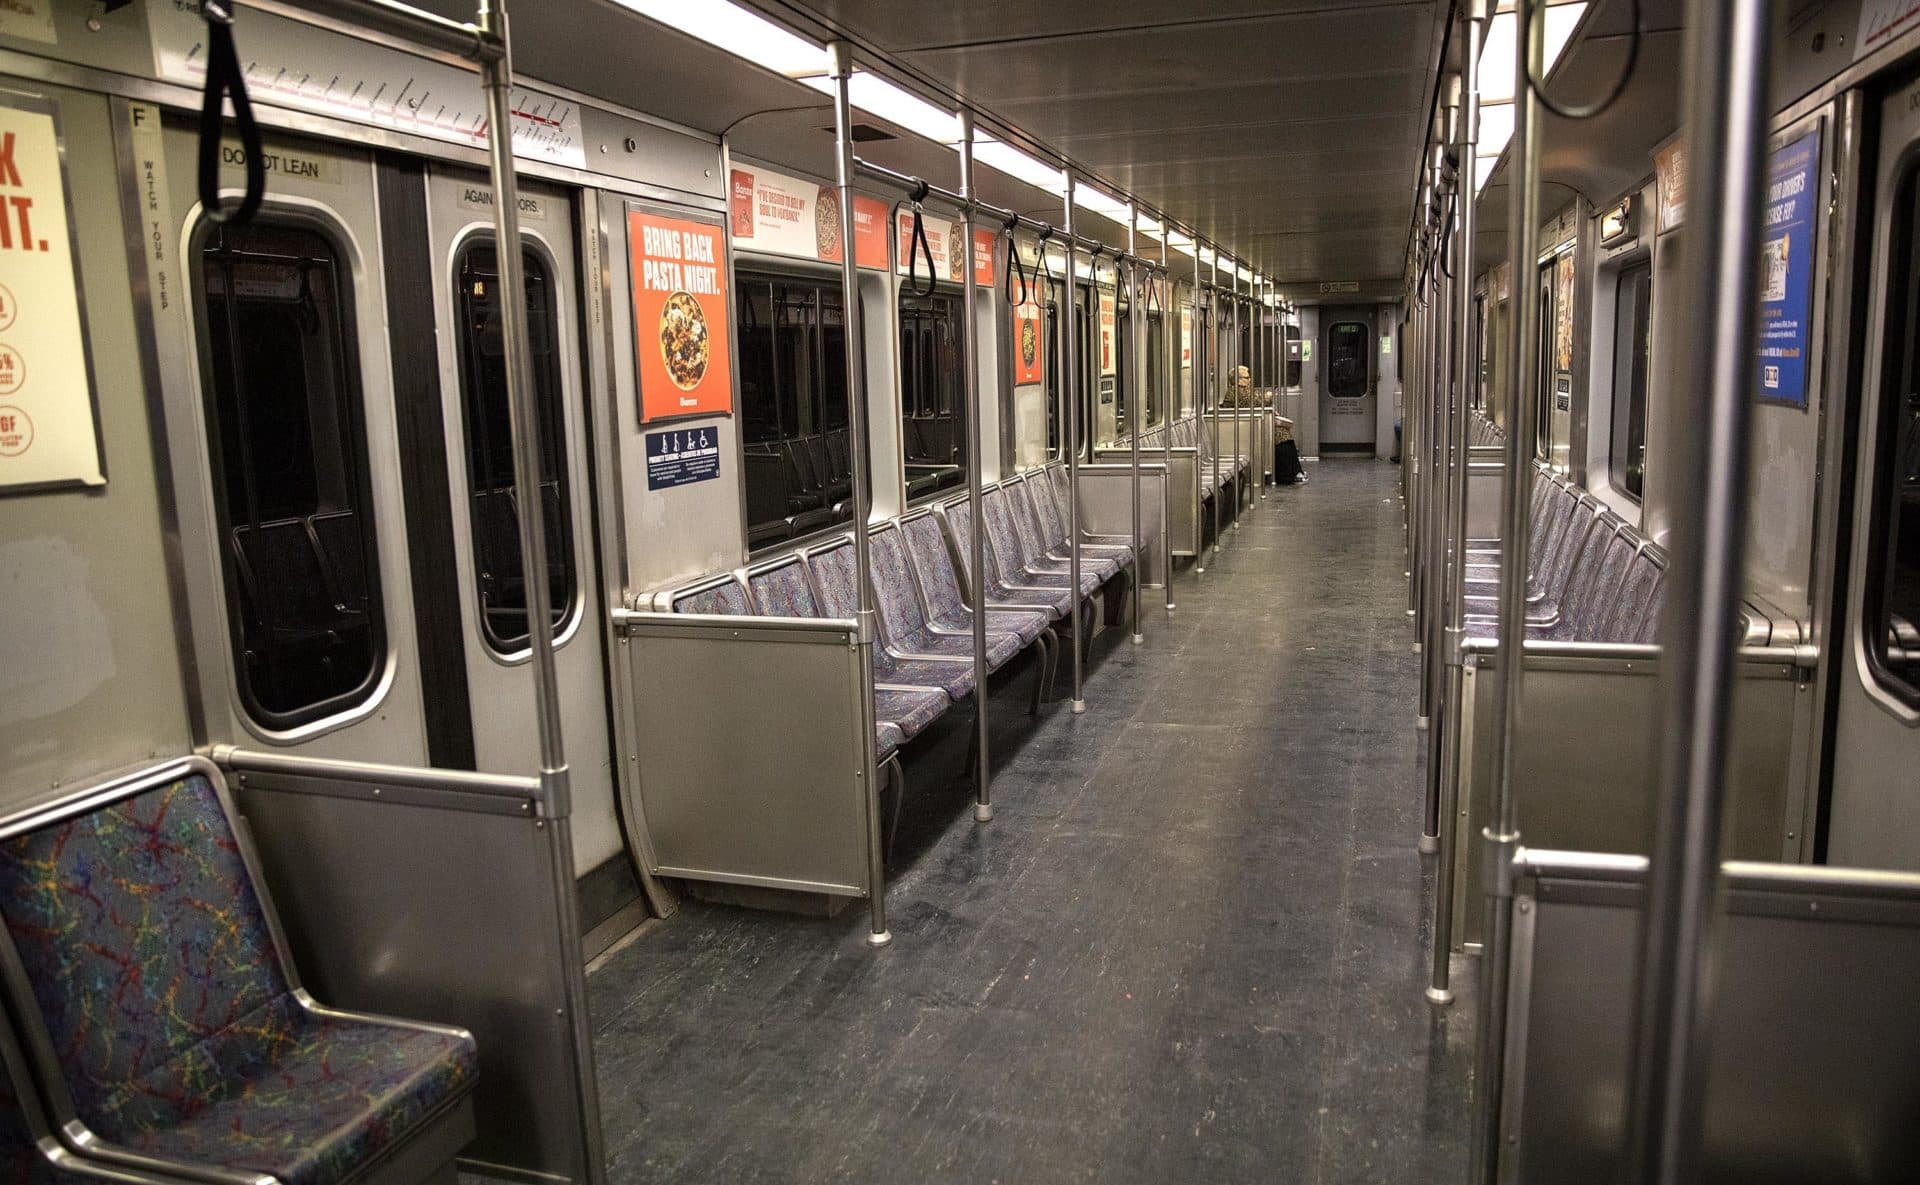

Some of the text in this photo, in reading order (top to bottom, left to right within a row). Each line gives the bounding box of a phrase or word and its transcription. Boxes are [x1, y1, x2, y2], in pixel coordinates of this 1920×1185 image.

[133, 108, 145, 127] F
[223, 147, 246, 165] DO
[283, 157, 319, 178] LEAN
[143, 160, 169, 310] WATCH YOUR STEP
[643, 225, 714, 264] BRING BACK
[643, 259, 720, 295] PASTA NIGHT.
